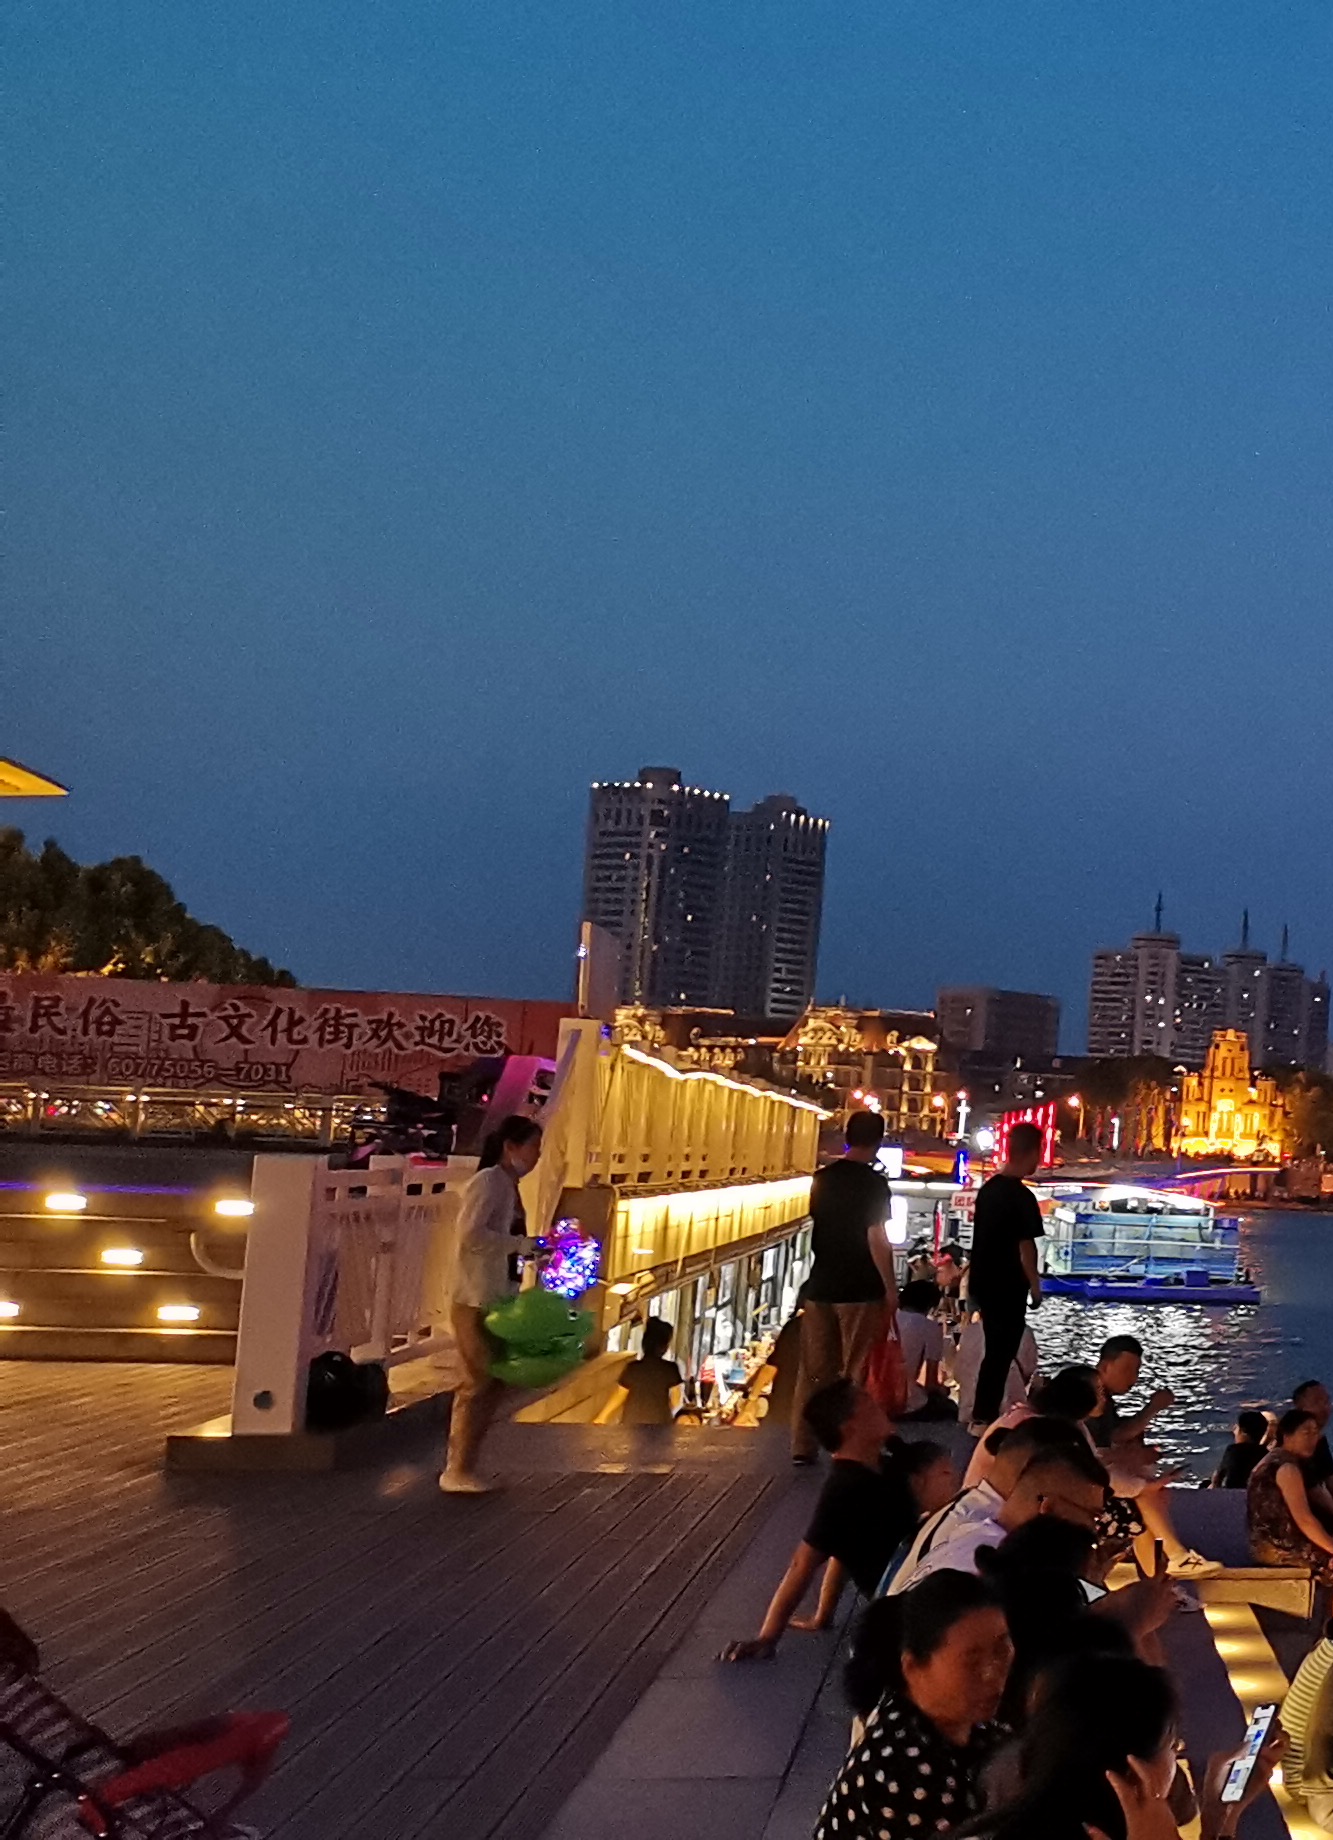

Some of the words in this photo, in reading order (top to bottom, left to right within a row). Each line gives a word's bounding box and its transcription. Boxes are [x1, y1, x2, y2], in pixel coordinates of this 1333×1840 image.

[159, 999, 504, 1055] 古文化街欢迎您
